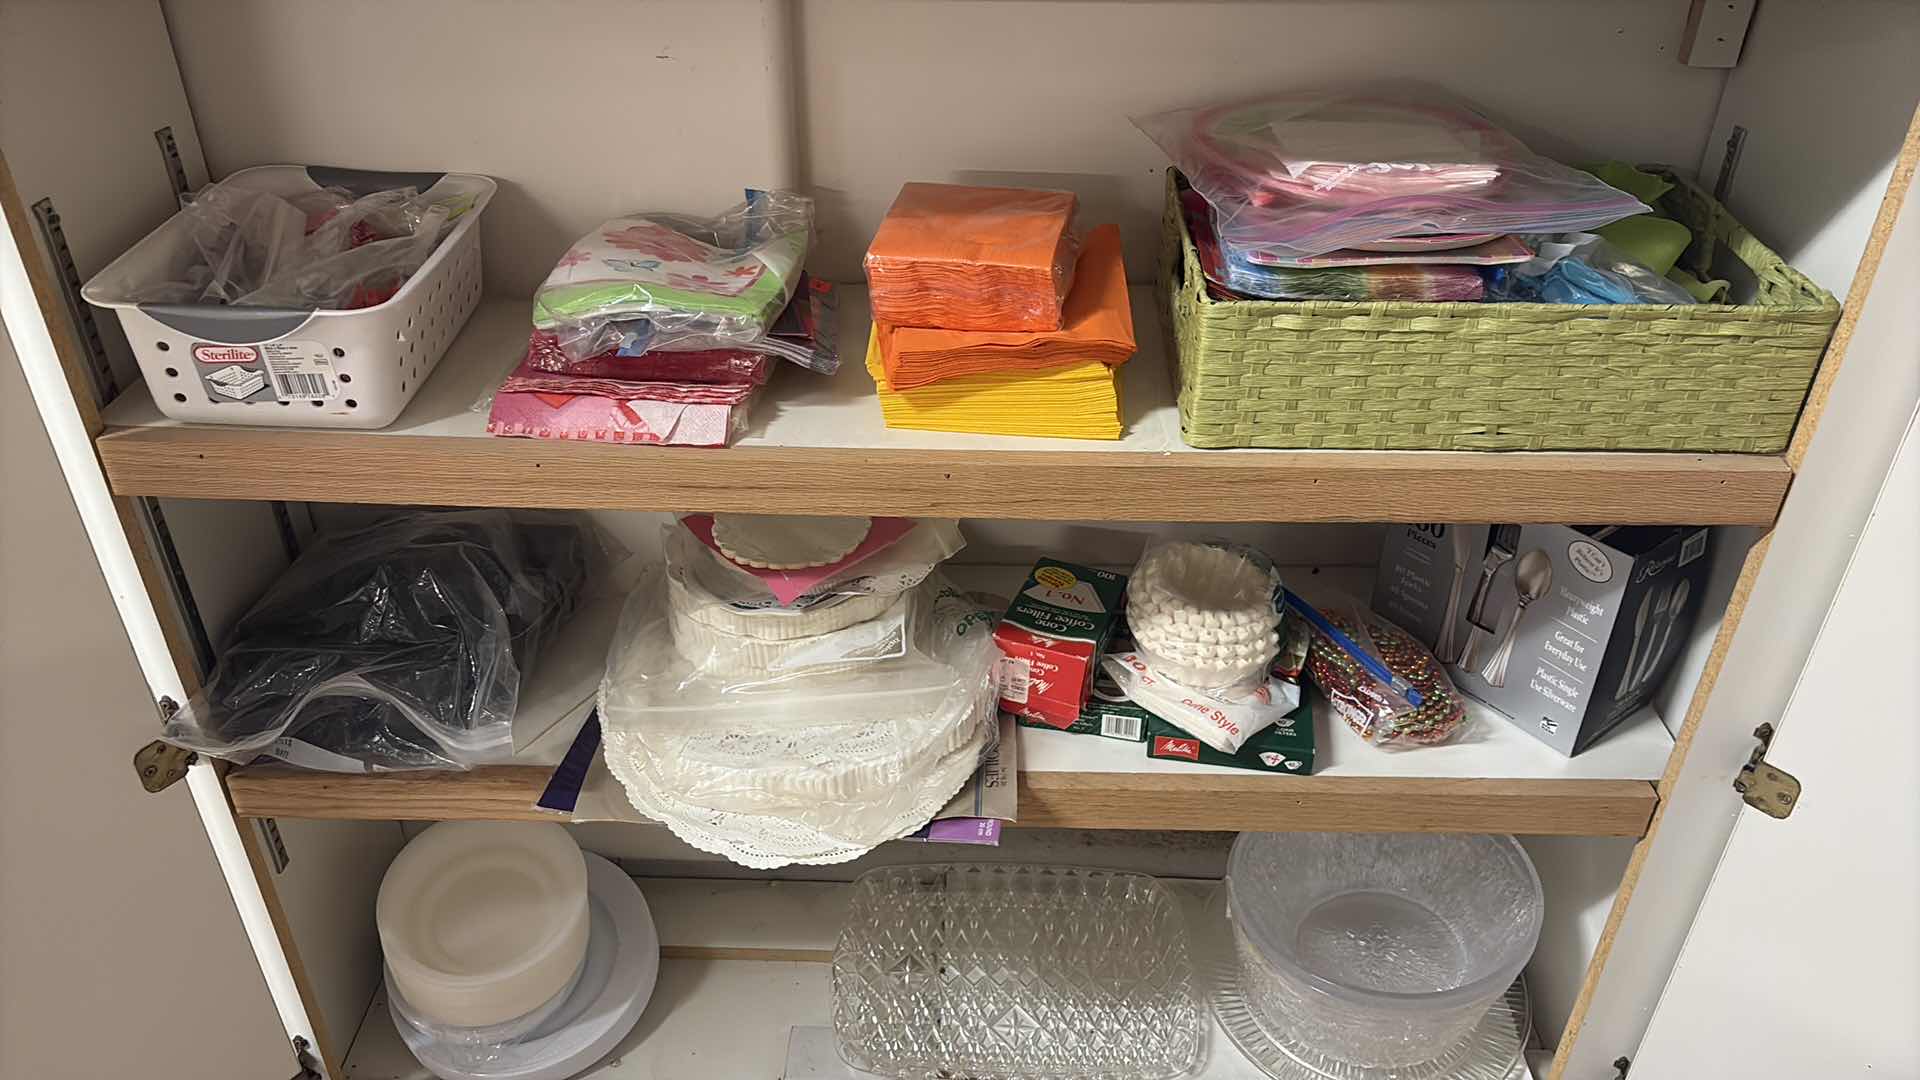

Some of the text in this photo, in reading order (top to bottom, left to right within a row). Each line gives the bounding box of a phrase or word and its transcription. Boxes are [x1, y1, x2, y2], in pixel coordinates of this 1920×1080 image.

[201, 349, 253, 361] Sterilite
[1096, 569, 1118, 580] 100
[1060, 592, 1085, 605] No.
[1016, 605, 1096, 631] Coffee Filters
[1566, 607, 1590, 625] Plastic
[1035, 619, 1068, 632] Cone
[1554, 631, 1586, 654] Great for
[1543, 640, 1588, 671] Everyday Use
[1035, 660, 1059, 672] Coffee
[1535, 667, 1580, 699] Plastic Single
[1529, 679, 1577, 713] Use Silverware
[1209, 709, 1241, 737] Style
[1160, 739, 1195, 755] Melitta
